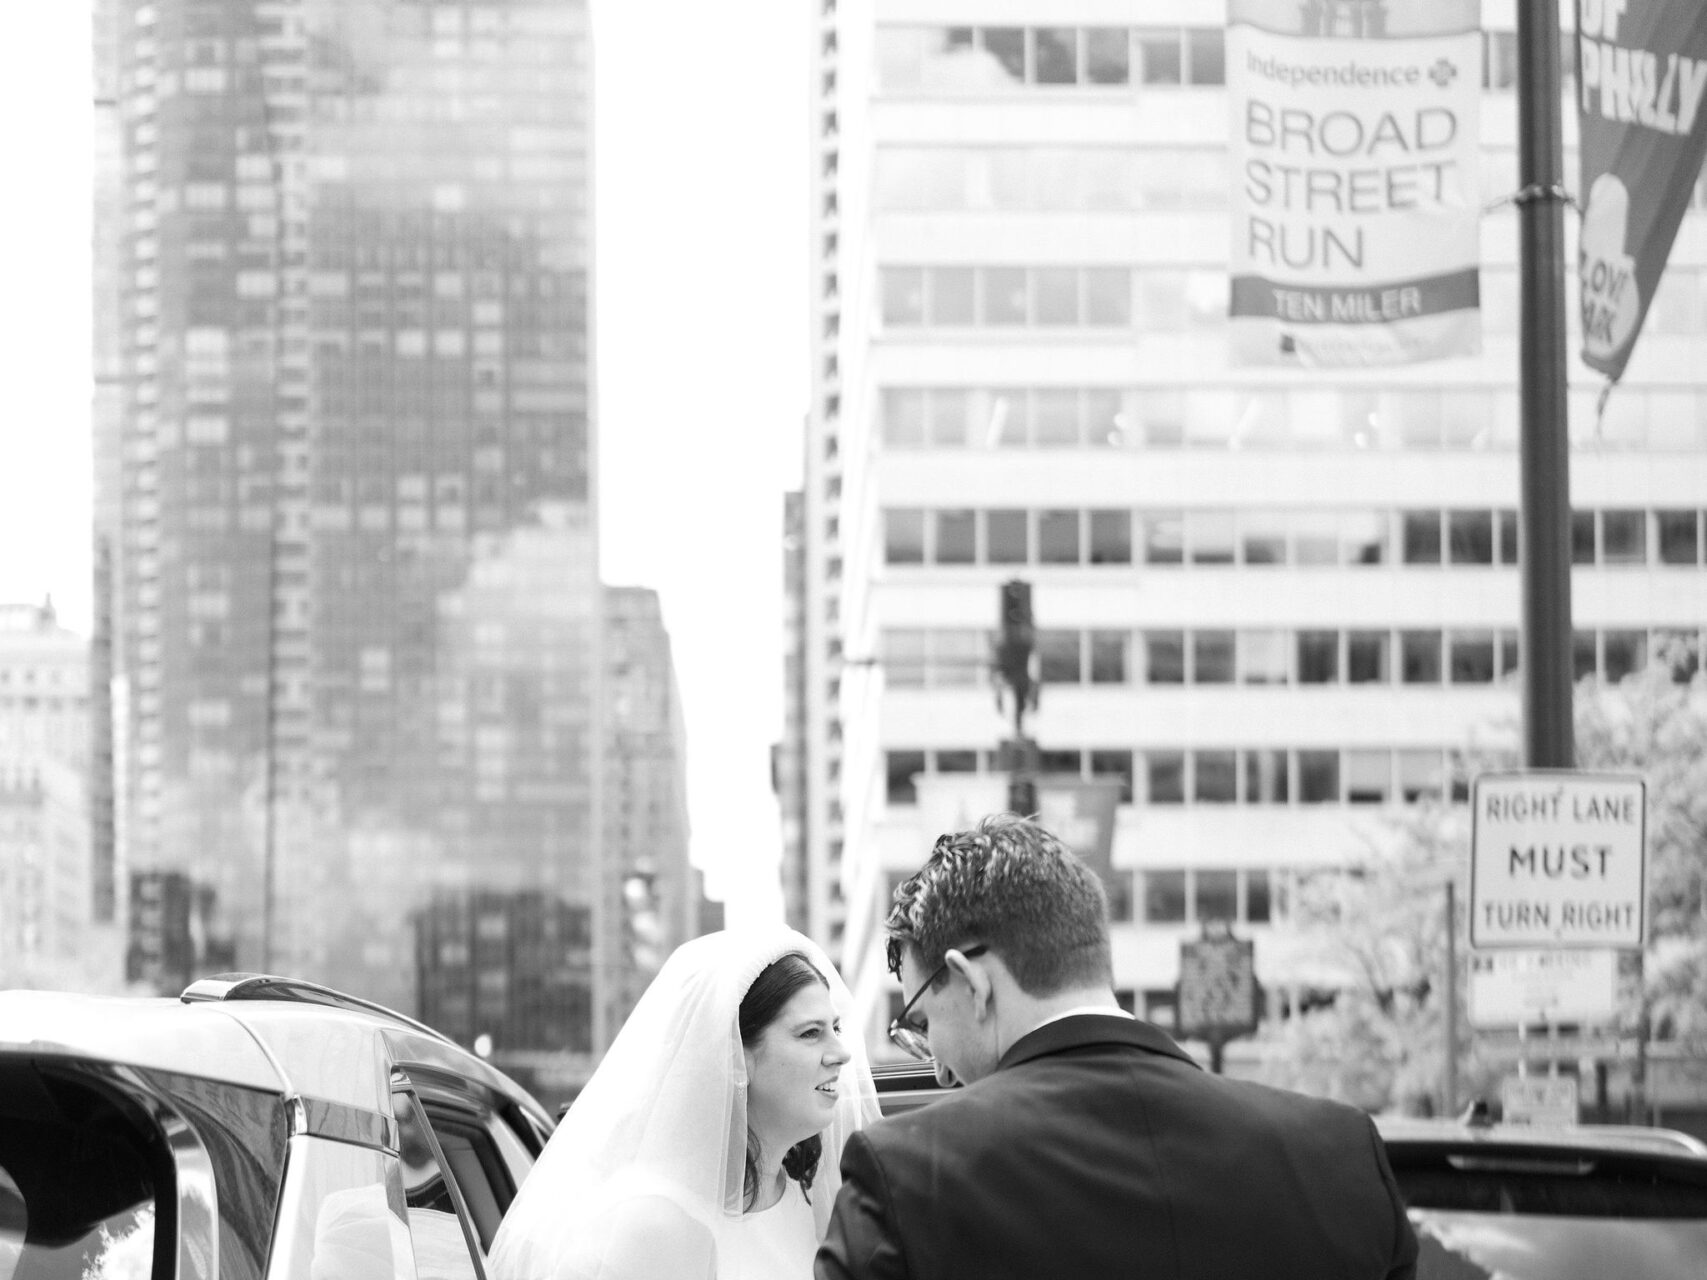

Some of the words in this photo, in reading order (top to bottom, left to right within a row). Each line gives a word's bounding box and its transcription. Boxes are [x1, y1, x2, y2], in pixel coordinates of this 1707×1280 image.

[1247, 50, 1420, 88] Independence
[1246, 99, 1458, 157] BROAD
[1246, 159, 1457, 213] STREET
[1248, 216, 1364, 269] RUN
[1272, 288, 1325, 321] TEN
[1331, 286, 1423, 322] MILER
[1485, 796, 1560, 823] RIGHT
[1573, 797, 1635, 824] LANE
[1508, 846, 1612, 878] MUST
[1484, 902, 1550, 930] TURN
[1561, 902, 1635, 930] RIGHT
